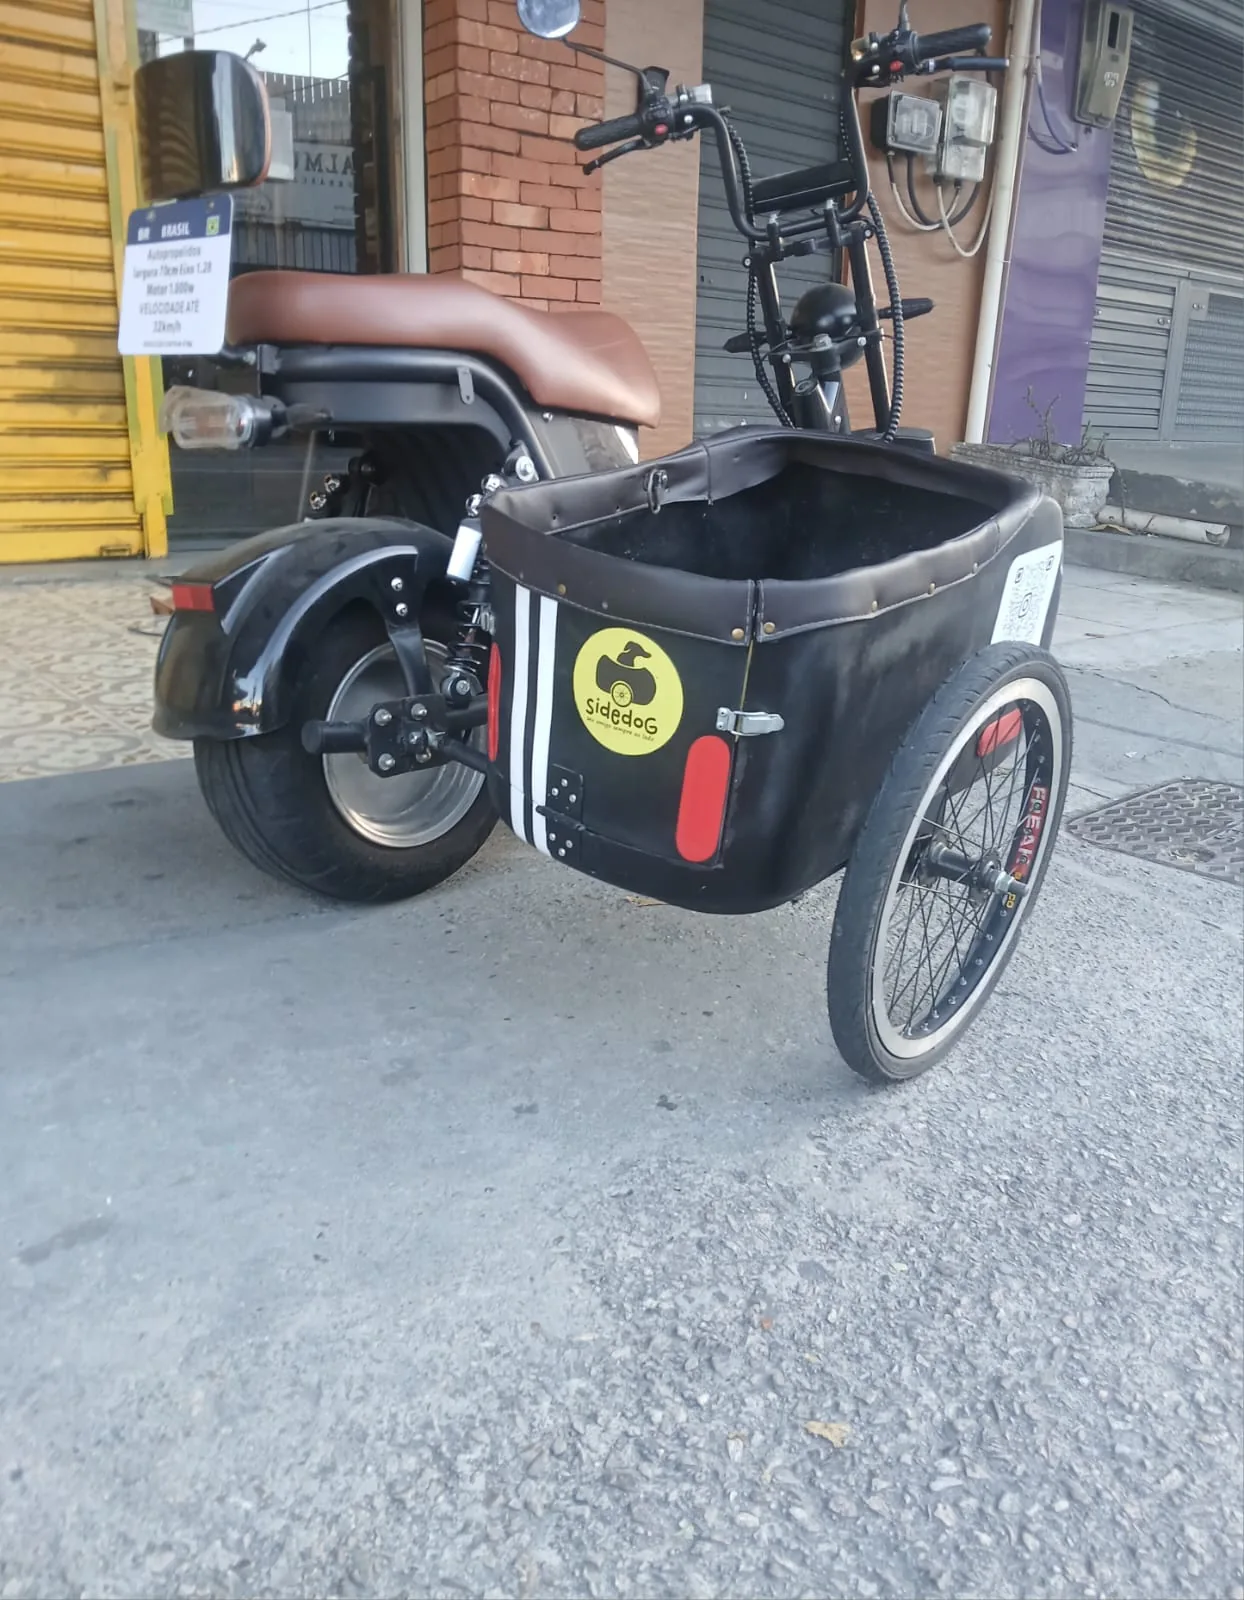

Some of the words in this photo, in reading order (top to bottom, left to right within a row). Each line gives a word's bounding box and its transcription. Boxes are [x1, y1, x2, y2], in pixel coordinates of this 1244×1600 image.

[138, 227, 150, 241] BR
[161, 222, 190, 238] BRASIL
[147, 284, 168, 296] Motor
[140, 301, 185, 315] VELOCIDADE
